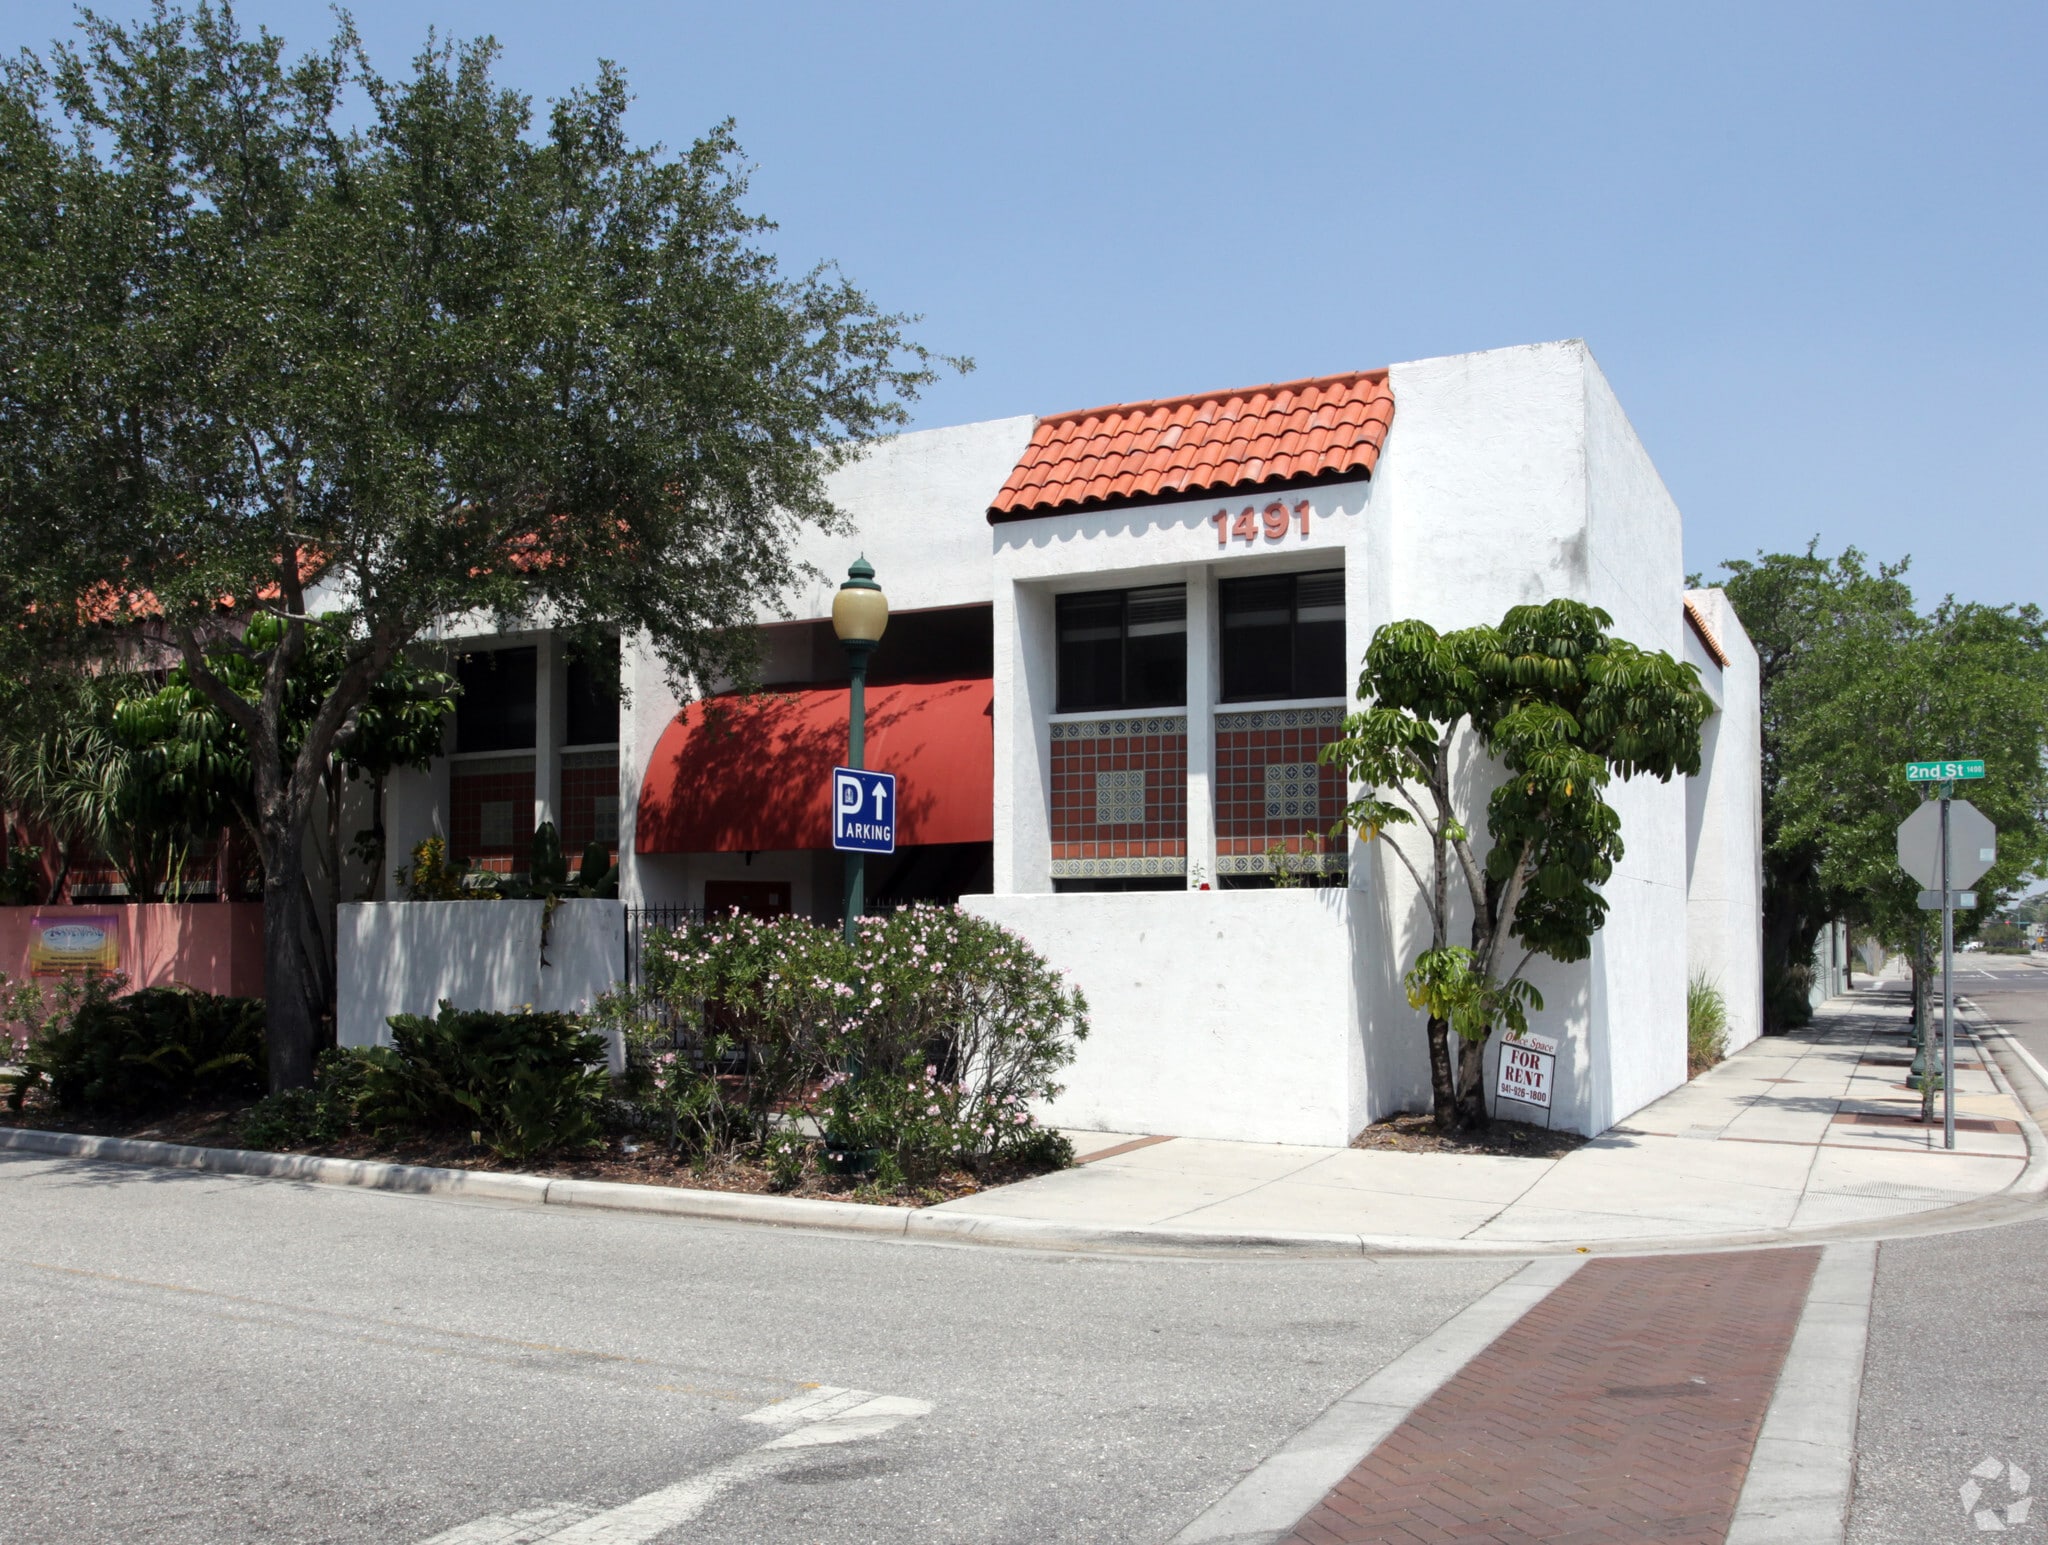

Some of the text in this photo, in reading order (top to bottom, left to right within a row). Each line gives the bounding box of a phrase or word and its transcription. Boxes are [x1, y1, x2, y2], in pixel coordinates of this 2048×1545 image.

[1212, 499, 1310, 544] 1491
[1909, 764, 1940, 779] 2nd
[1945, 763, 1964, 777] St
[837, 774, 891, 842] PARKING
[1530, 1037, 1554, 1053] Space
[1511, 1049, 1540, 1070] FOR
[1505, 1066, 1544, 1088] RENT
